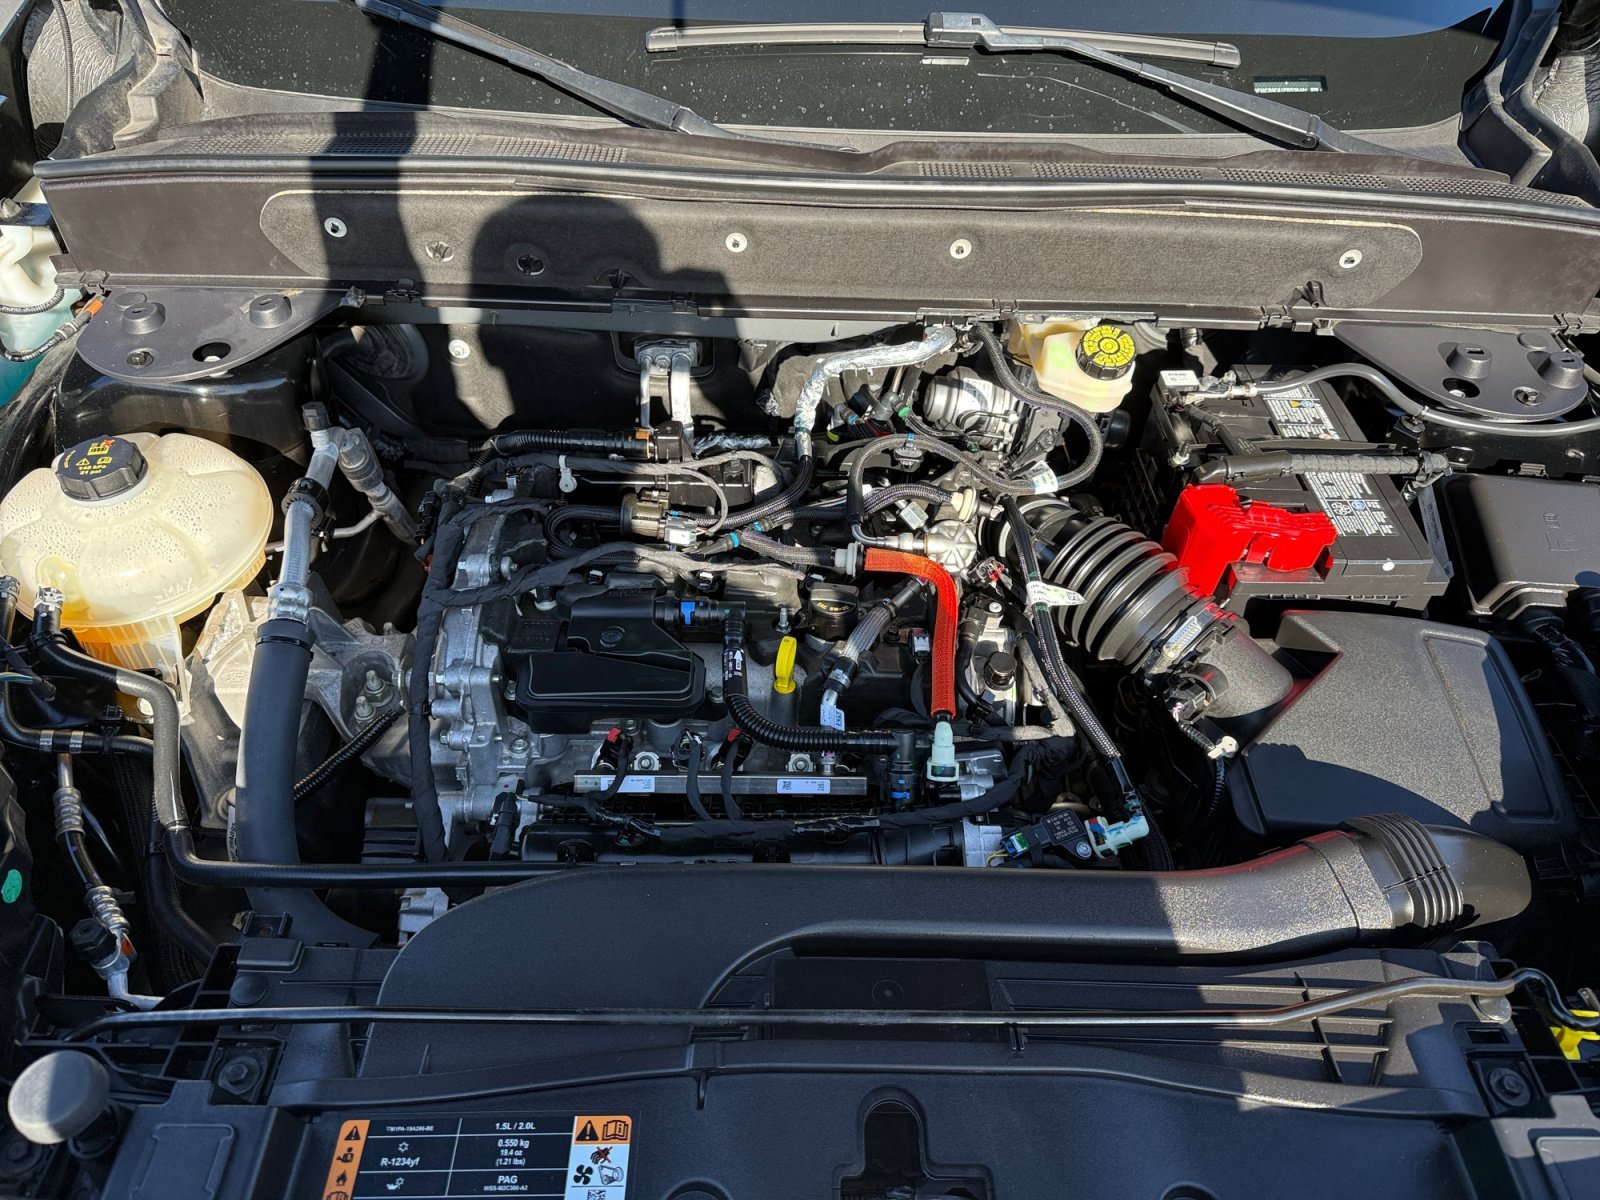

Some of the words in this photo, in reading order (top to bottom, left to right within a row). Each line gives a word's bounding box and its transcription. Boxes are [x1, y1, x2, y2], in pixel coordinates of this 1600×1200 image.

[495, 1122, 512, 1130] 1.5L
[518, 1122, 536, 1130] 2.0L
[497, 1139, 519, 1147] 0.550
[519, 1138, 530, 1148] kg
[380, 1157, 421, 1168] R-1234yf
[512, 1158, 526, 1166] lbs)
[497, 1175, 518, 1184] PAG
